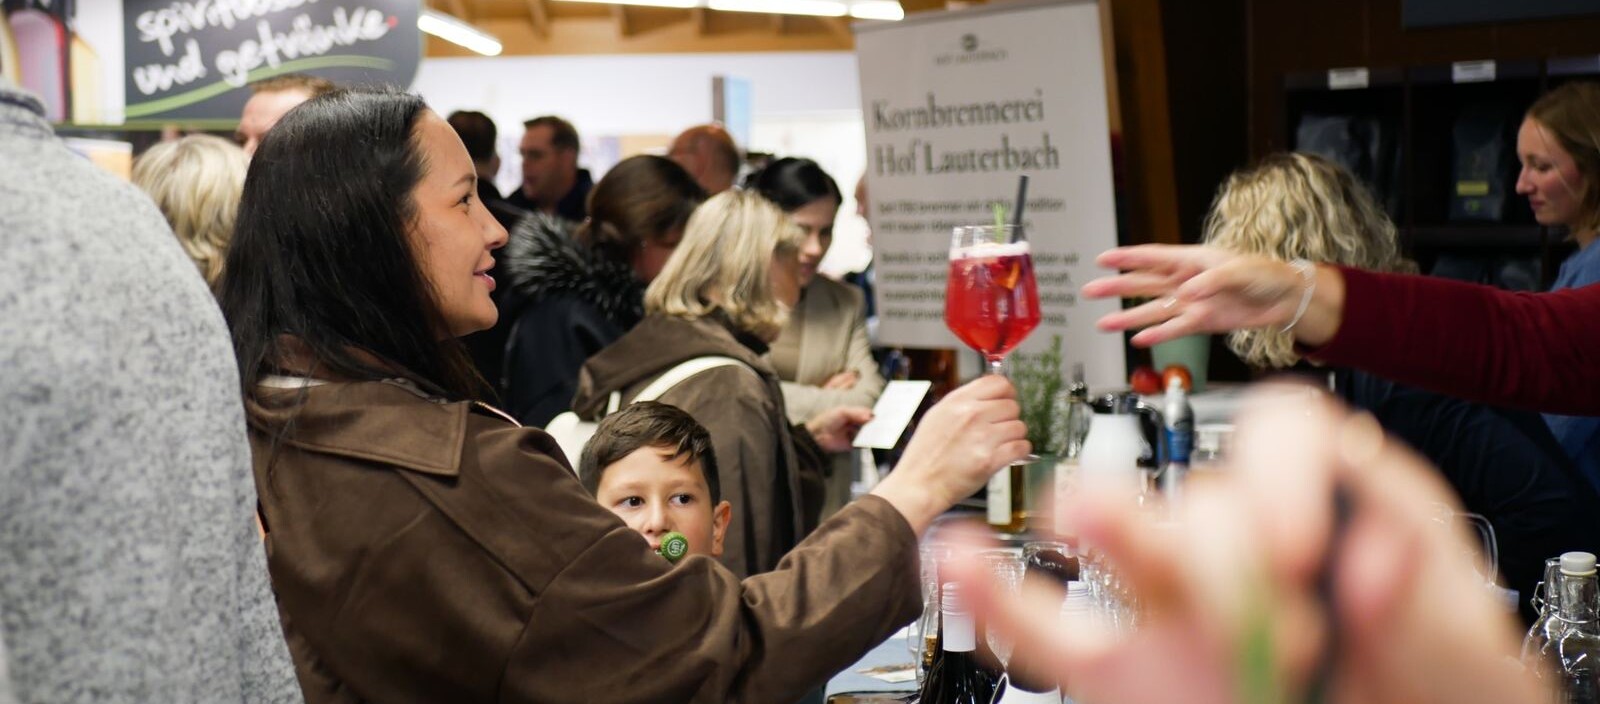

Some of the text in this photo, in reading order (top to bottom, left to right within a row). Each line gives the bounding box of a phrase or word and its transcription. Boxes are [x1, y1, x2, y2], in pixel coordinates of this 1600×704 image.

[134, 39, 207, 95] und
[872, 87, 1044, 132] Kornbrennerei
[875, 130, 1060, 176] Hof Lauterbach
